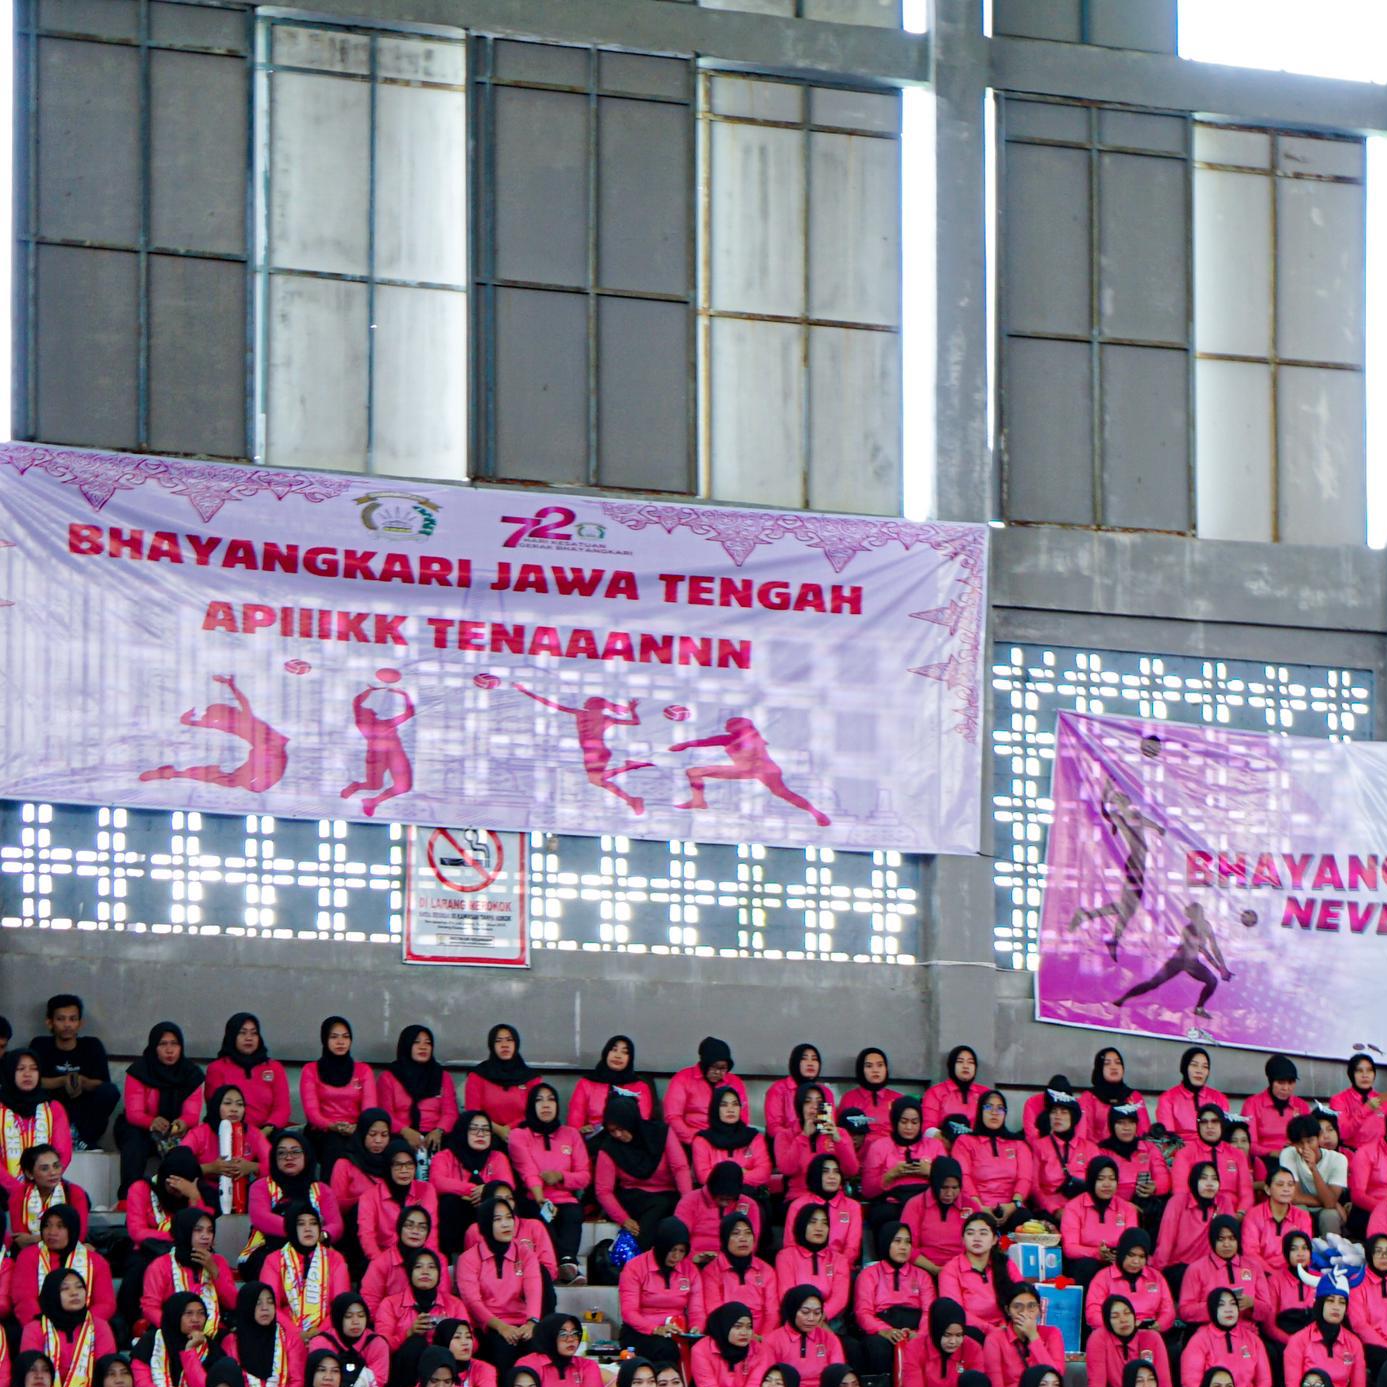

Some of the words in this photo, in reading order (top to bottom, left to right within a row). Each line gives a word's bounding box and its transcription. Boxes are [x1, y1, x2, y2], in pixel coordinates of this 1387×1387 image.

[502, 506, 576, 549] 72
[68, 523, 472, 588] BHAYANGKARI
[490, 561, 640, 601] JAWA
[658, 573, 863, 615] TENGAH
[202, 600, 408, 647] APIIIKK
[426, 617, 753, 670] TENAAANNN
